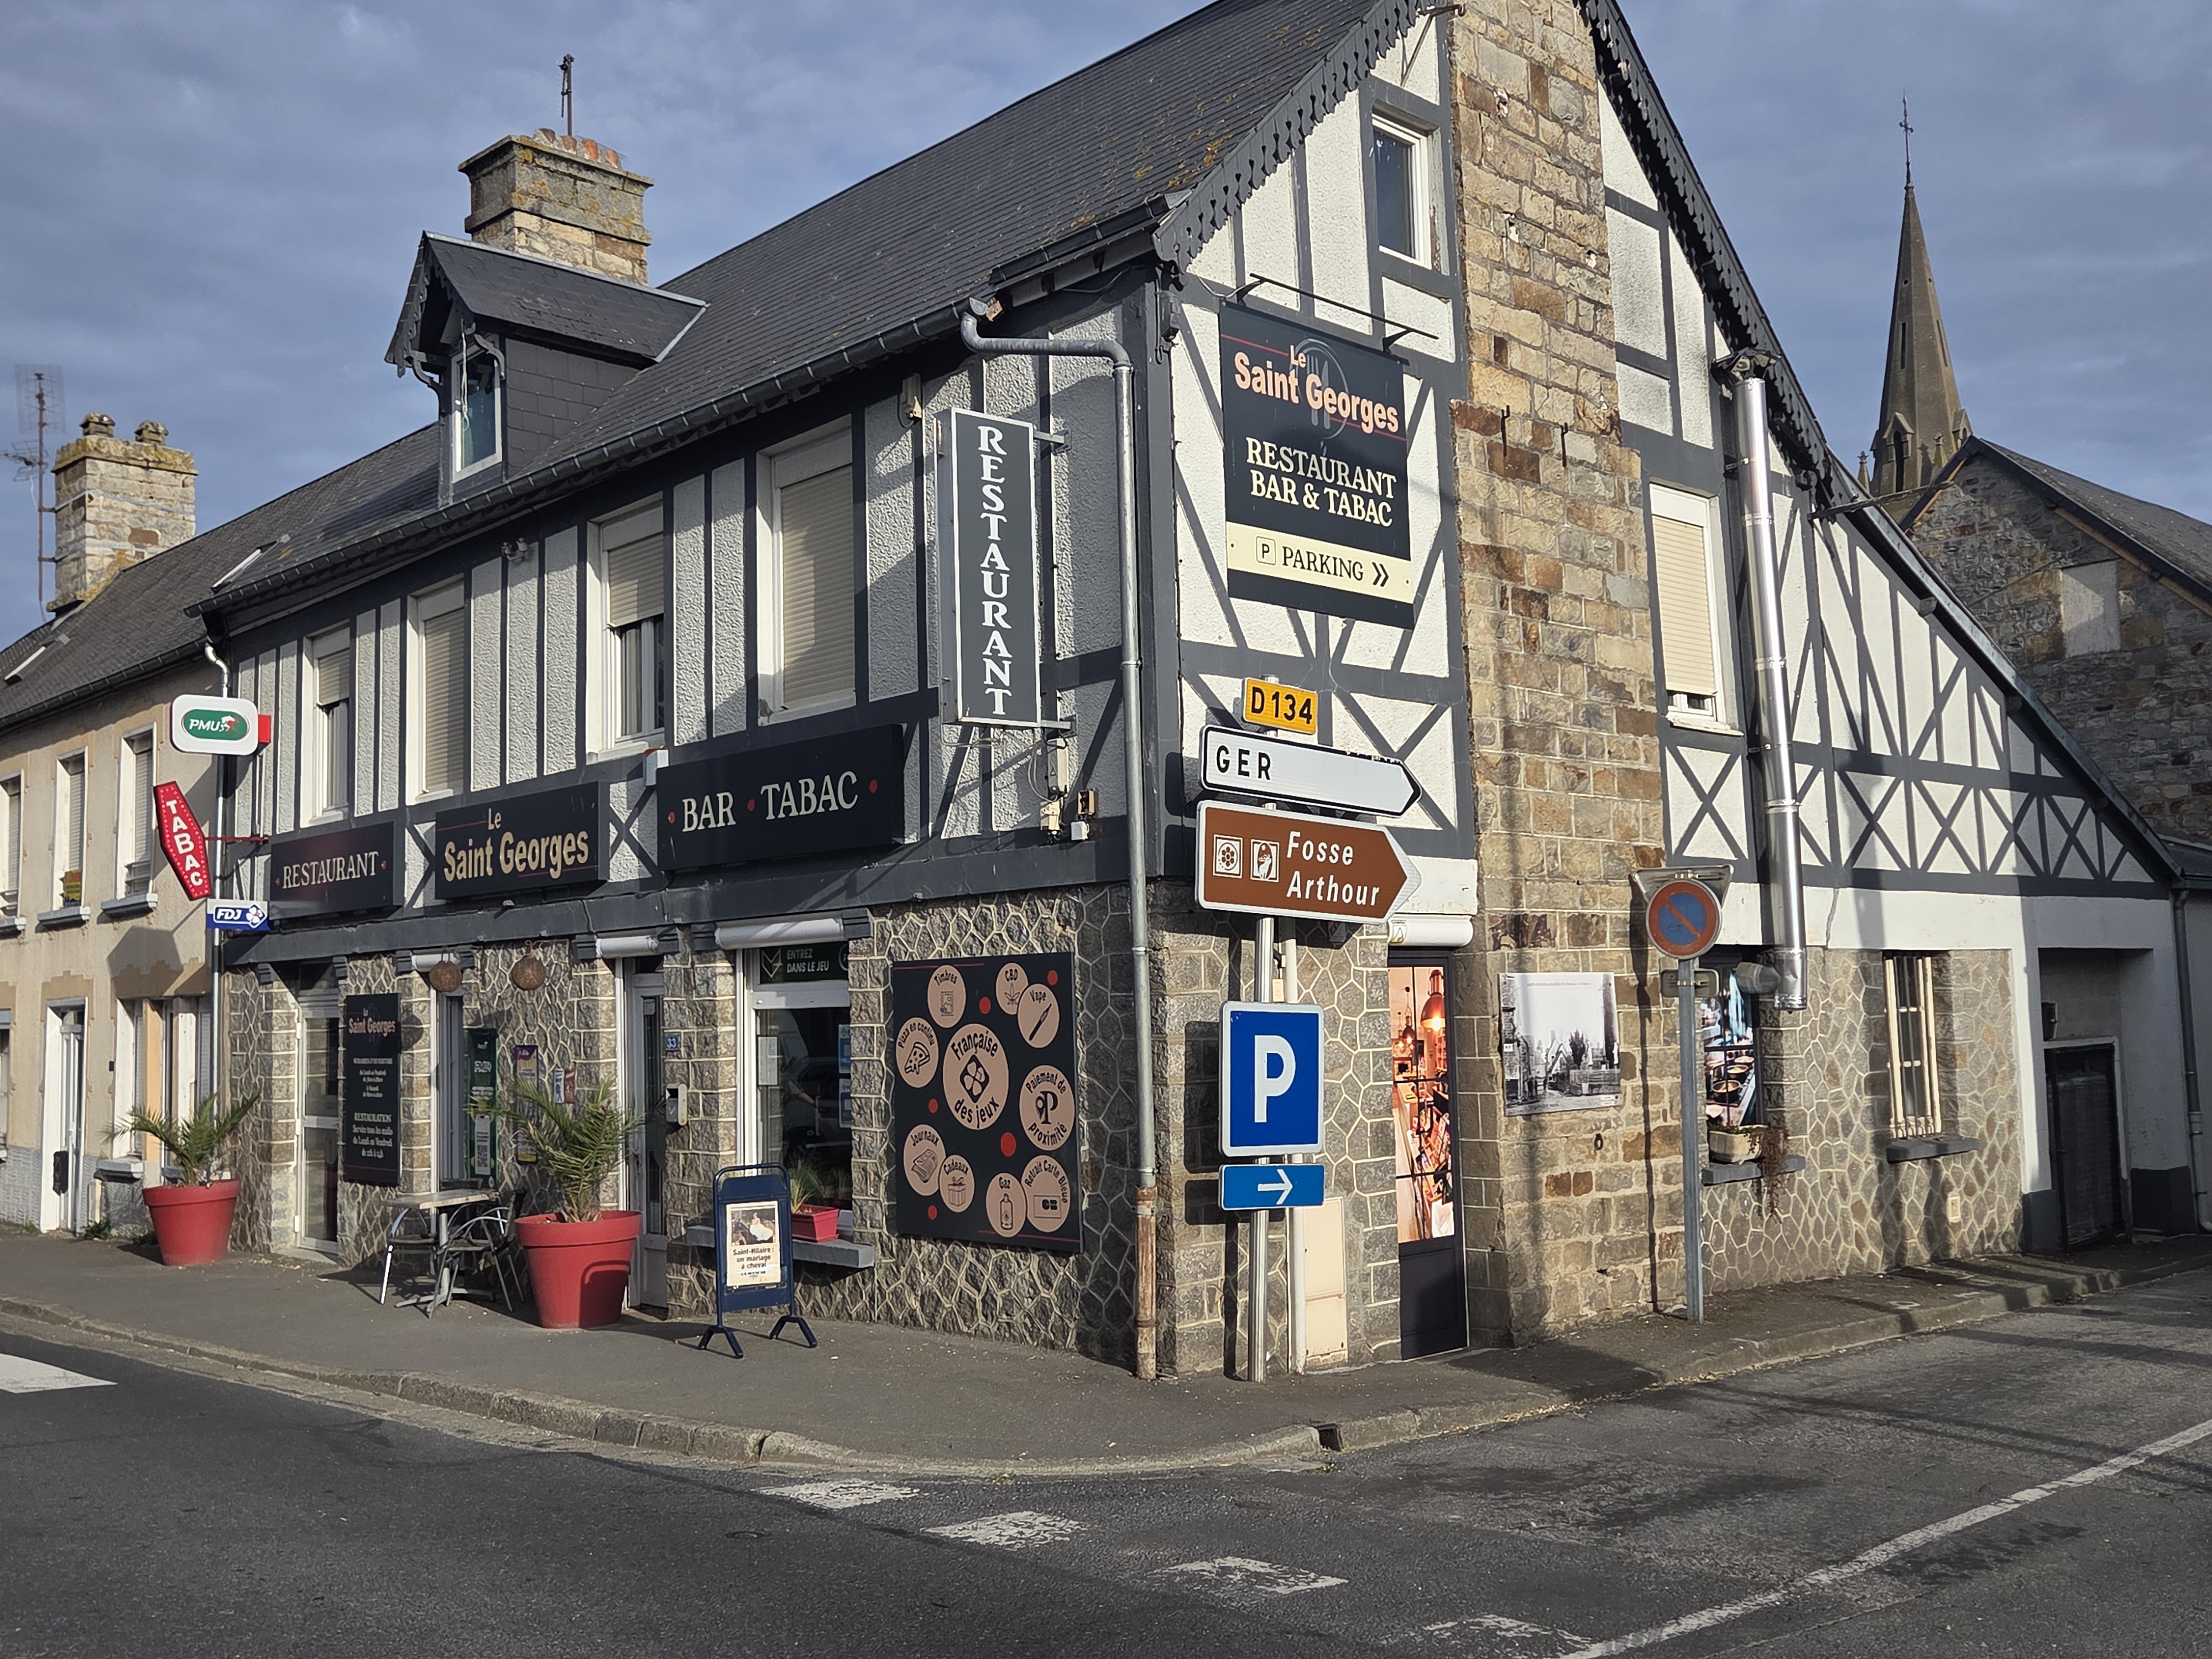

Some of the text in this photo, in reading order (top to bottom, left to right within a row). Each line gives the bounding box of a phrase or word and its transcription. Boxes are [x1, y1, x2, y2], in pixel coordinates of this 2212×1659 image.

[1290, 345, 1306, 367] Le
[1234, 352, 1399, 434] Saint Georges
[1246, 436, 1396, 498] RESTAURANT
[1250, 469, 1392, 526] BAR & TABAC
[977, 425, 1013, 715] RESTAURANT
[1282, 546, 1364, 581] PARKING
[1251, 687, 1312, 724] D 134
[189, 719, 220, 731] PMU
[1216, 745, 1271, 780] GER
[682, 771, 858, 832] BAR TABAC
[488, 808, 502, 830] Le
[166, 800, 204, 886] TABAC
[444, 831, 589, 881] Saint Georges
[1287, 831, 1353, 865] Fosse
[283, 852, 379, 889] RESTAURANT
[1286, 871, 1380, 906] Arthour
[217, 909, 242, 920] FDJ
[787, 948, 813, 959] ENTREZ
[787, 961, 829, 973] DANS LE JEU
[933, 969, 957, 986] Timbres
[1005, 968, 1018, 982] CBD
[1029, 990, 1046, 1004] Vape
[367, 1017, 395, 1037] Georges
[898, 1027, 910, 1048] Pizza
[917, 1022, 935, 1046] continu
[667, 1037, 676, 1048] 33
[951, 1030, 998, 1061] Française
[1026, 1072, 1067, 1094] Paiement de
[1254, 1035, 1296, 1123] P
[954, 1096, 999, 1129] des jeux
[910, 1130, 939, 1147] Journaux
[1027, 1121, 1067, 1146] proximité
[943, 1159, 969, 1175] Cadeaux
[1025, 1161, 1042, 1187] Retrait
[1044, 1160, 1060, 1178] Carte
[999, 1176, 1010, 1189] Gaz
[733, 1247, 771, 1255] Saint-Hilaire
